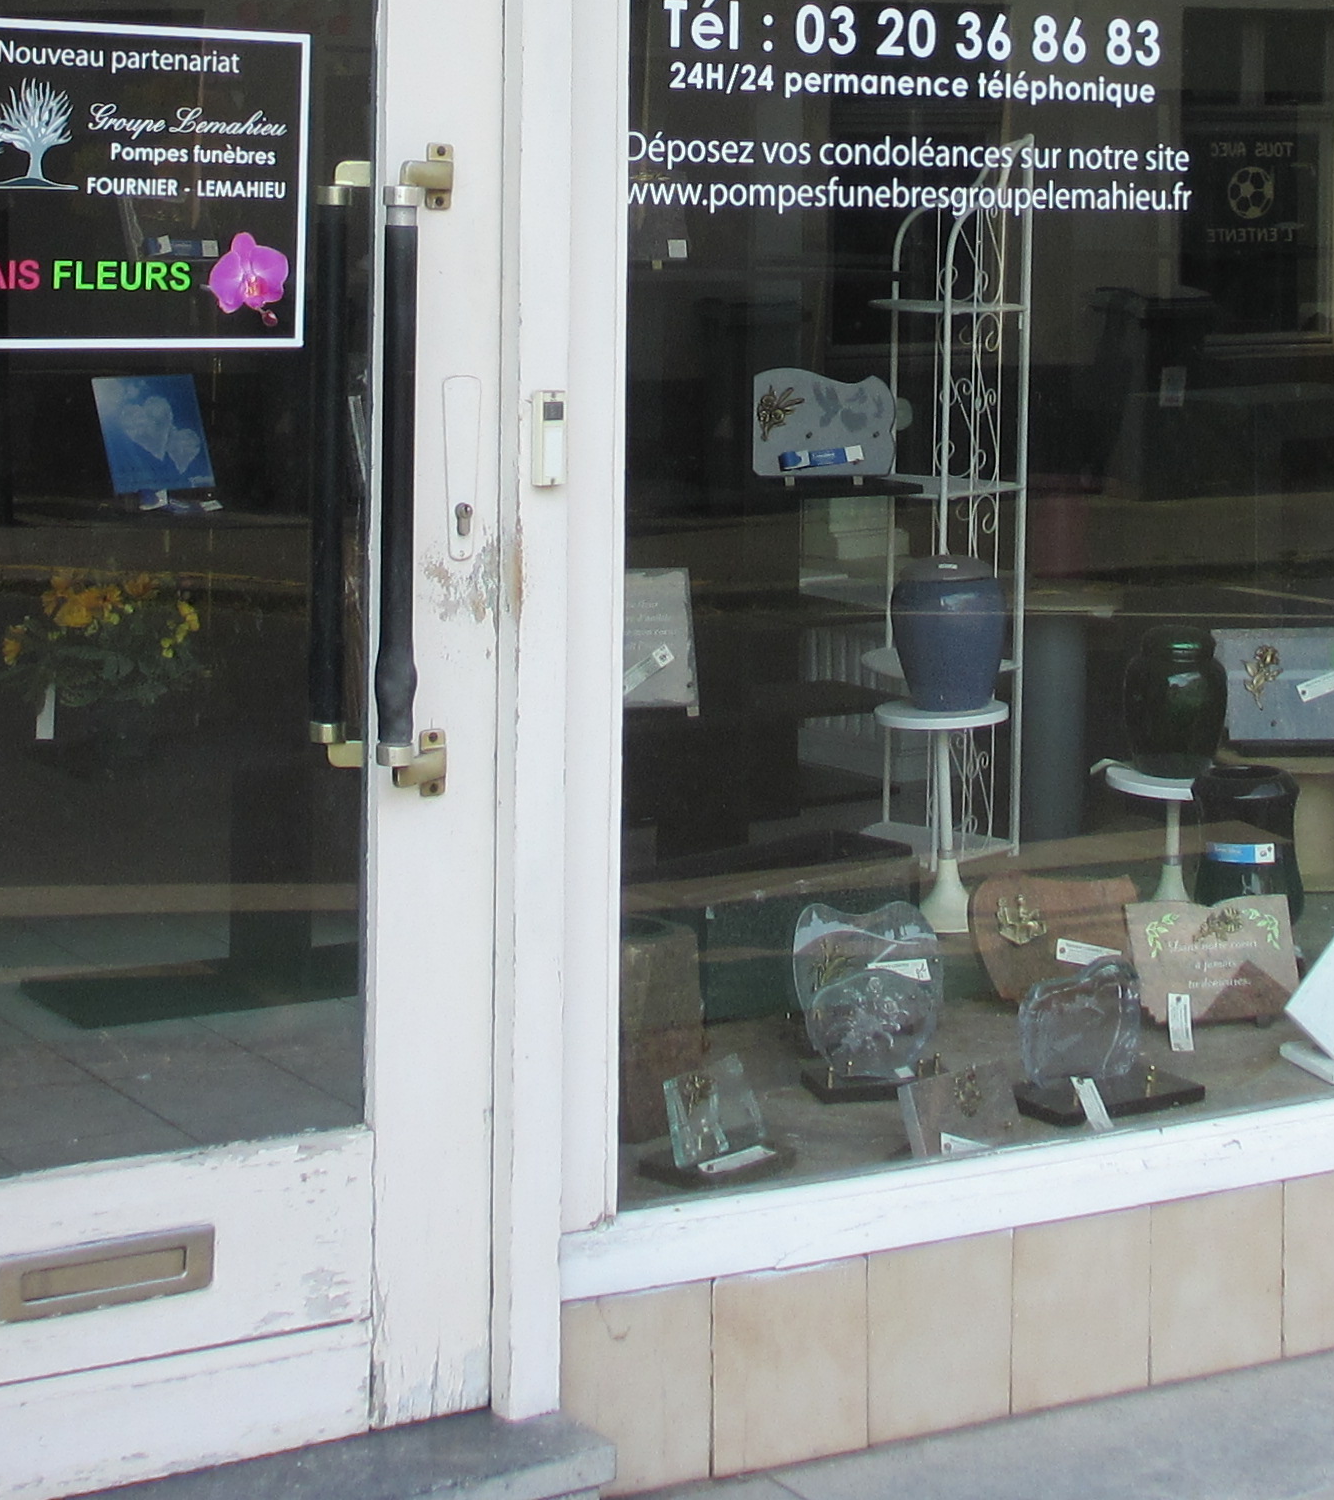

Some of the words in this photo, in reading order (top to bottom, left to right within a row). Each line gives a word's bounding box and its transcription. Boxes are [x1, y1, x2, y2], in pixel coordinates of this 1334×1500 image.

[762, 13, 774, 52] :
[795, 4, 857, 56] 03
[875, 8, 936, 58] 20
[956, 11, 1011, 61] 36
[1031, 15, 1087, 64] 86
[1105, 18, 1160, 67] 83
[110, 47, 241, 74] partenariat
[669, 62, 774, 94] 24H/24
[785, 67, 969, 99] permanence
[978, 71, 1156, 108] téléphonique
[88, 102, 165, 140] Groupe
[169, 106, 288, 138] Lemahieu
[110, 142, 188, 168] Pompes
[193, 143, 276, 166] funèbres
[626, 131, 755, 171] Déposez
[763, 140, 811, 165] vos
[819, 136, 1014, 170] condoléances
[1020, 144, 1061, 170] sur
[1067, 144, 1139, 171] notre
[1144, 141, 1190, 172] site
[86, 176, 178, 197] FOURNIER
[196, 178, 287, 199] LEMAHIEU
[626, 176, 1192, 215] www.pompesfunebresgroupelemahieu.fr
[52, 259, 193, 292] FLEURS
